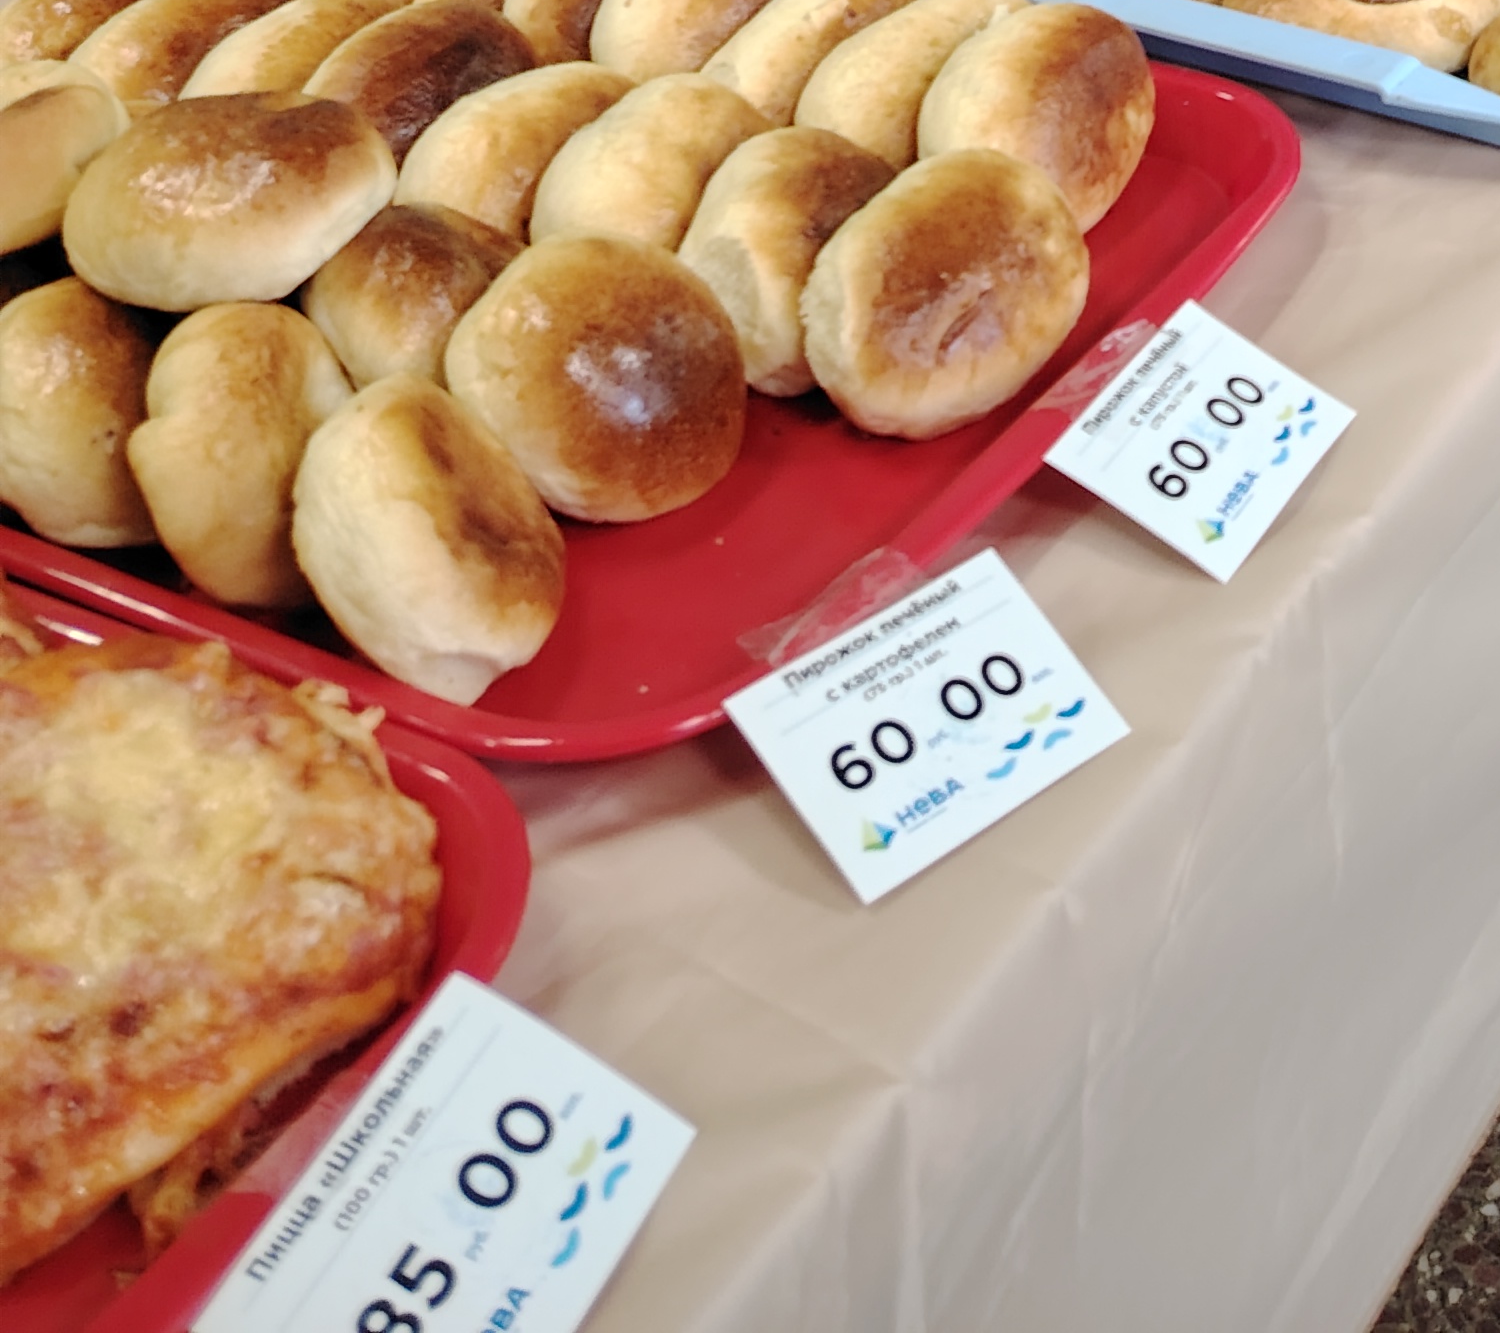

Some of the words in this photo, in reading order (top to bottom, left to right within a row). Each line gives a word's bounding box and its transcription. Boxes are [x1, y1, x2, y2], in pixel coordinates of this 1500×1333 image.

[1082, 379, 1138, 435] Пирожок
[1148, 438, 1211, 501] 60
[1205, 375, 1265, 429] 00
[783, 627, 879, 689] Пирожок
[878, 580, 963, 637] печёный
[825, 685, 842, 704] с
[830, 719, 917, 790] 60
[940, 654, 1023, 721] 00
[245, 1194, 322, 1282] Пицца
[322, 1026, 445, 1191] «Школьная»
[458, 1099, 555, 1210] 00
[335, 1187, 371, 1232] (100
